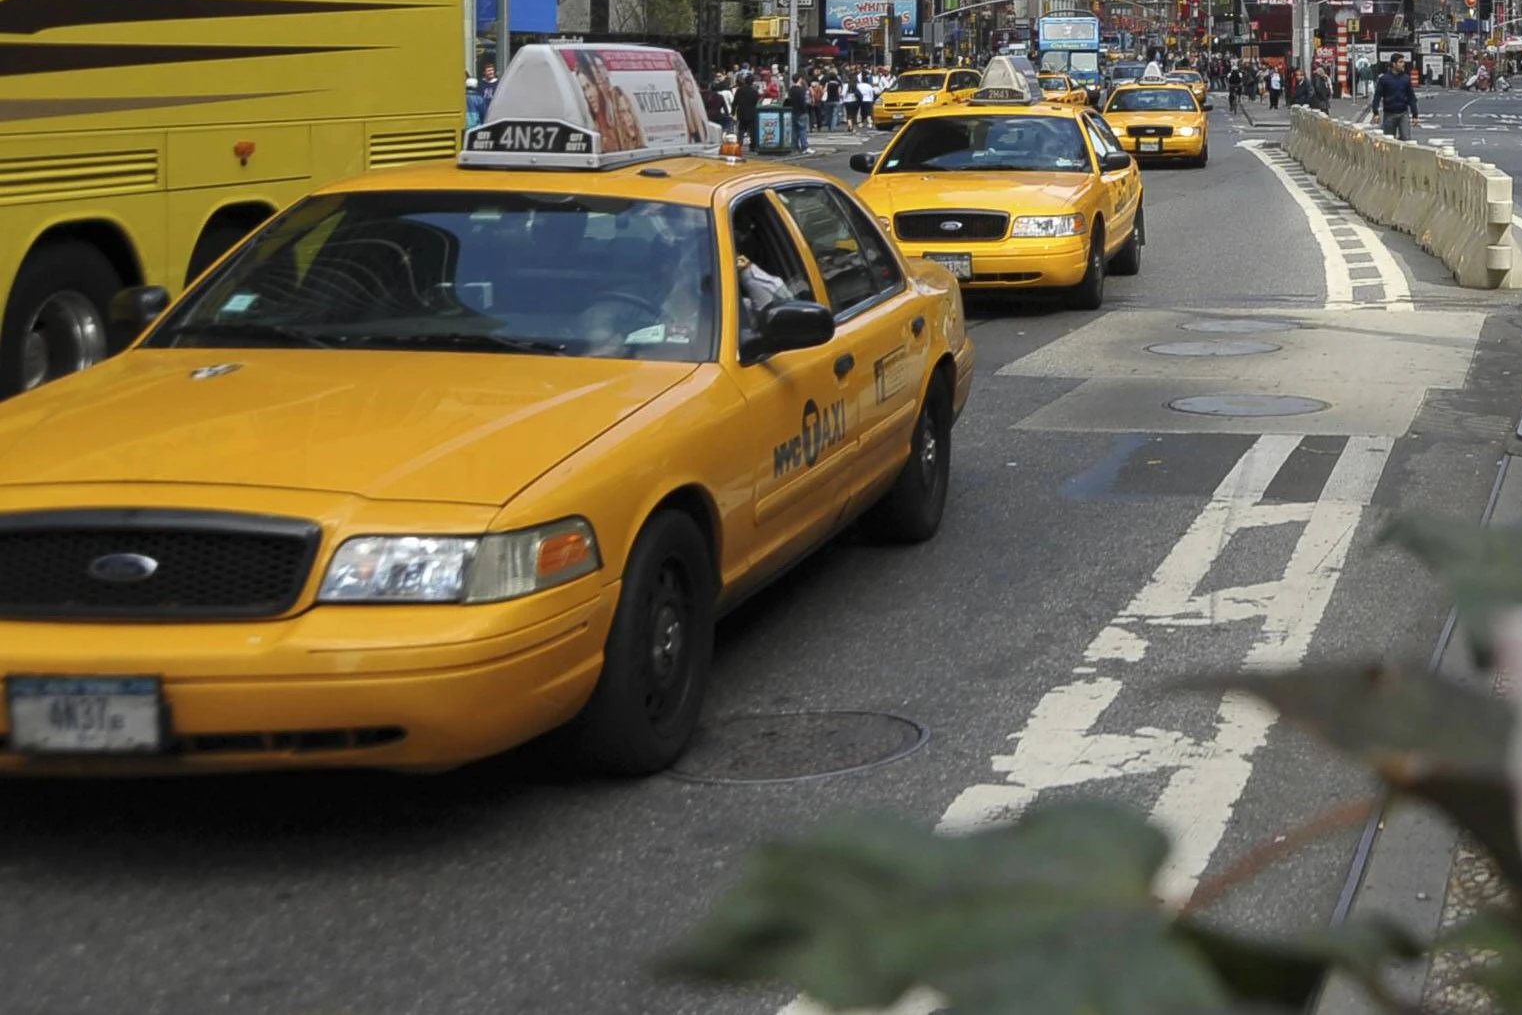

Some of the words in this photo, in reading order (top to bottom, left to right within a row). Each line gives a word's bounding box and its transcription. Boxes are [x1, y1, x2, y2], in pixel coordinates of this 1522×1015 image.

[473, 140, 494, 150] DUTY
[565, 142, 588, 152] DUTY
[500, 126, 559, 150] 4N37
